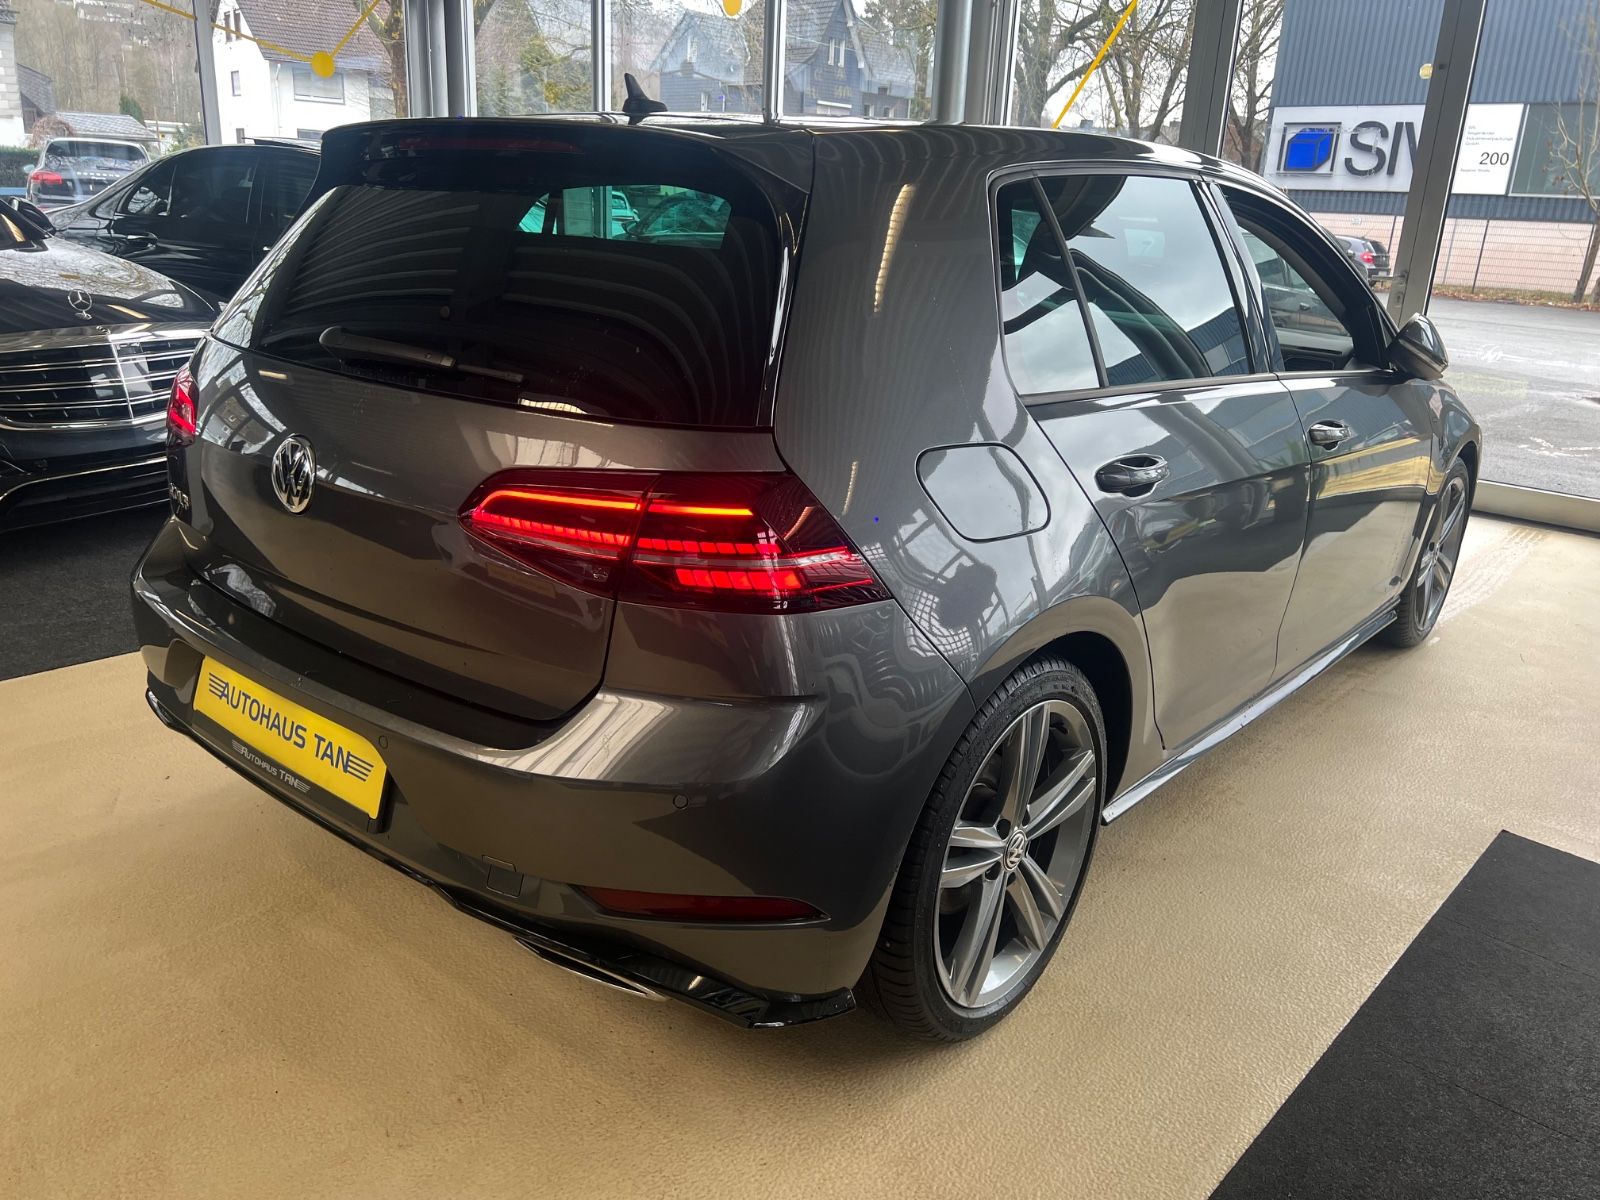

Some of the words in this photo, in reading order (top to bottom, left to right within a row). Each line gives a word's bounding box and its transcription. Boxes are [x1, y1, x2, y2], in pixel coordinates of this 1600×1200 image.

[1479, 152, 1510, 166] 200
[220, 682, 307, 750] AUTOHAUS
[314, 733, 351, 774] TAN
[240, 746, 278, 776] AUTOHAUS
[279, 769, 299, 788] TAN
